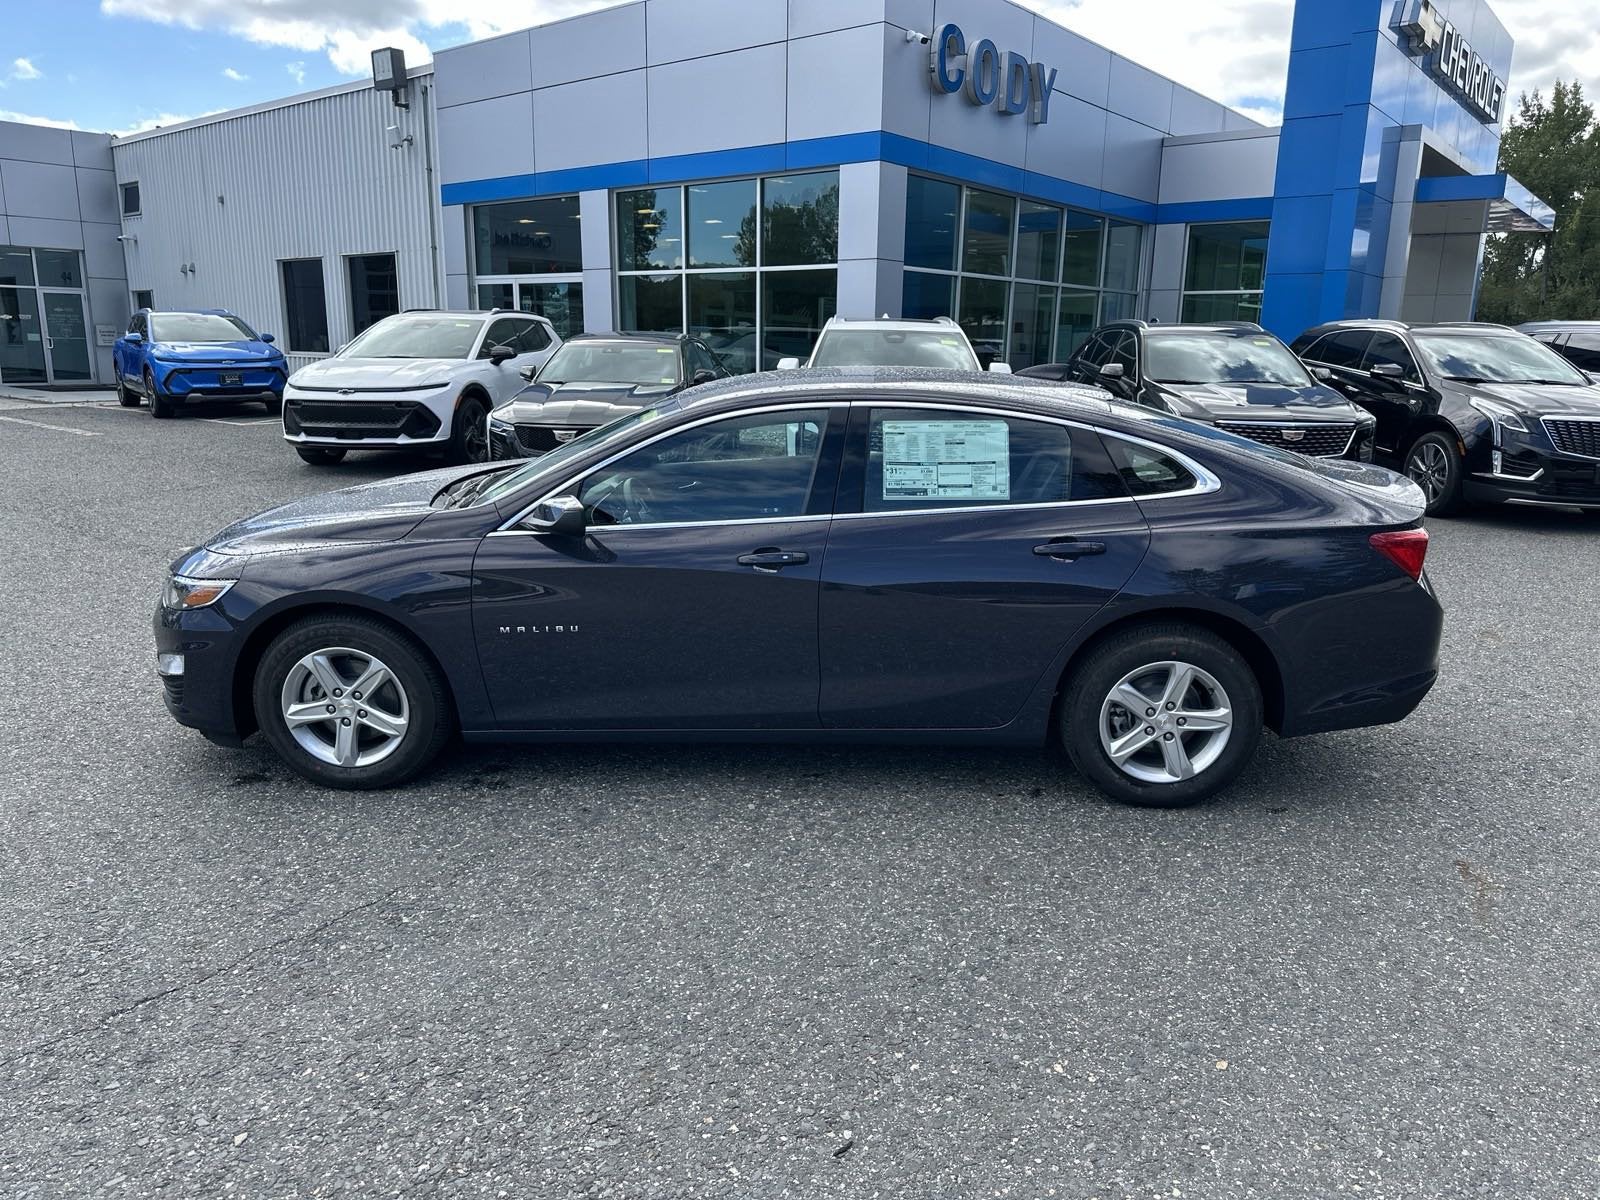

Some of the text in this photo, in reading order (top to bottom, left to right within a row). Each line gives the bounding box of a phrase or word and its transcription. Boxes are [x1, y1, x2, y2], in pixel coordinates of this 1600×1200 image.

[931, 23, 1058, 125] CODY
[1440, 20, 1506, 122] CHEVROLET
[499, 625, 579, 634] MALIBU
